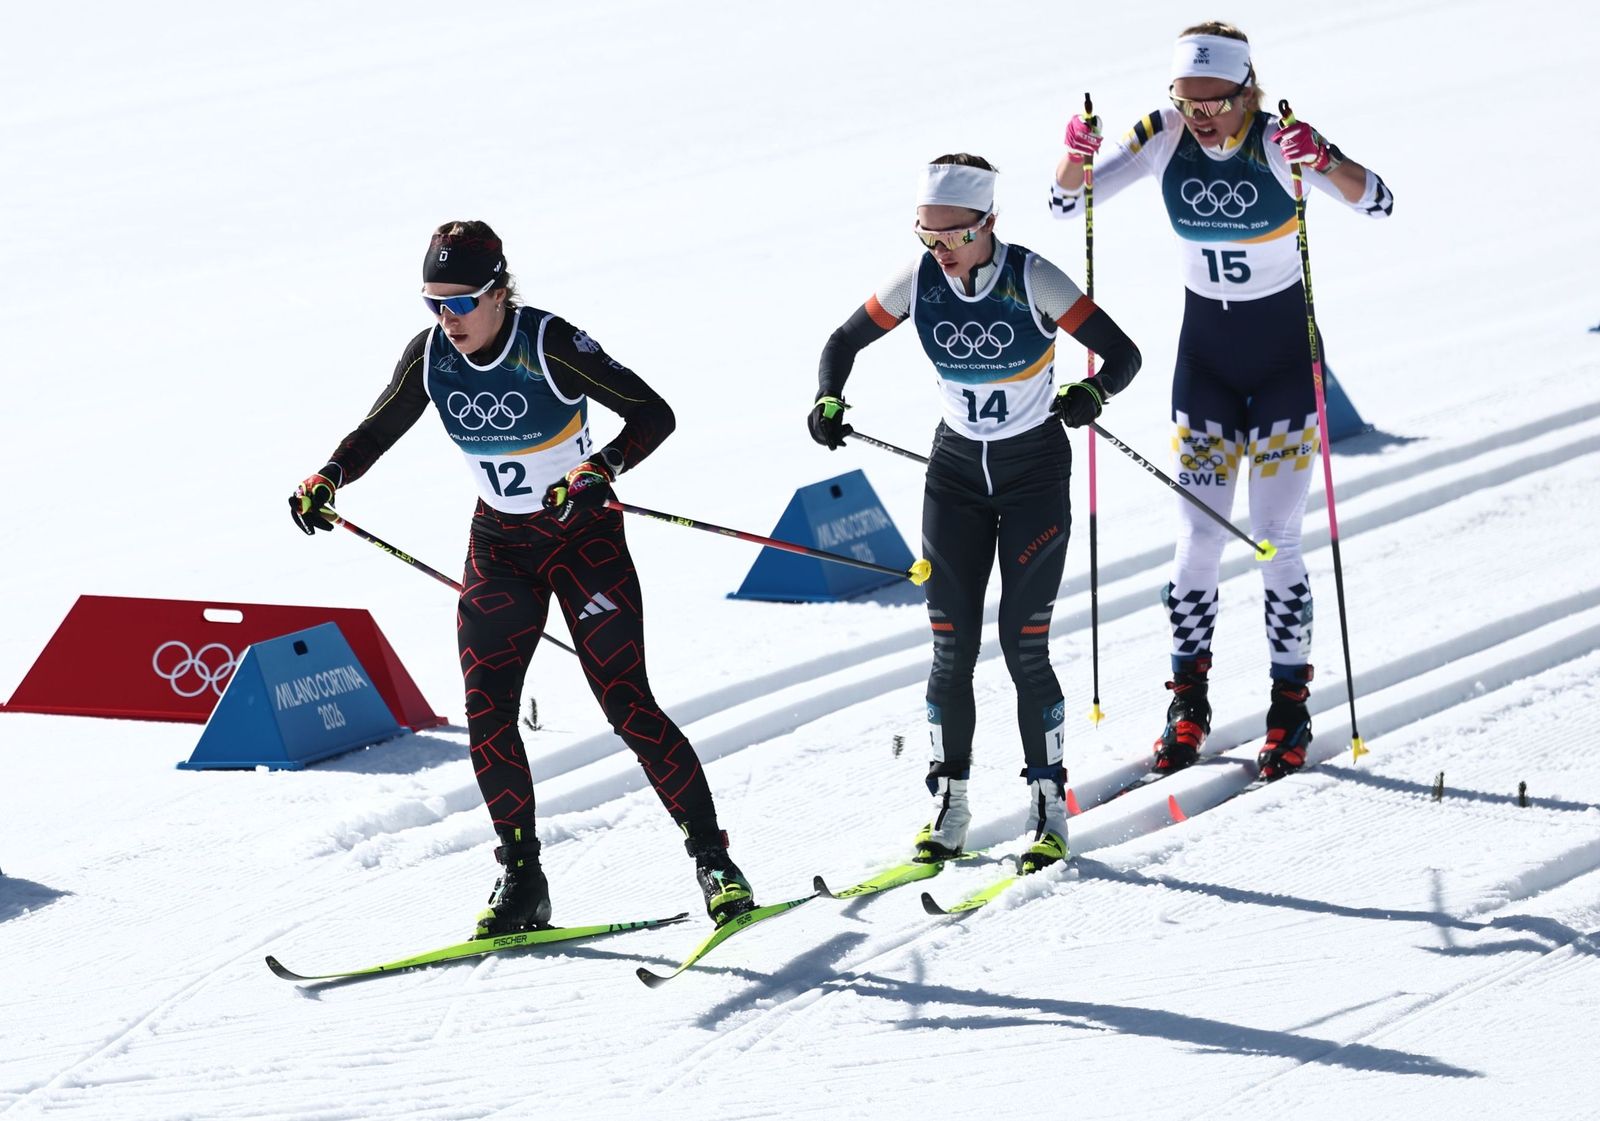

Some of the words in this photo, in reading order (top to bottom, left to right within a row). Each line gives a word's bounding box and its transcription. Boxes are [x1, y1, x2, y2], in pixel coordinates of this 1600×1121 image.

[1177, 218, 1211, 228] MILANO
[1211, 221, 1249, 230] CORTINA
[1250, 220, 1270, 230] 2026
[1296, 206, 1308, 252] LEKI
[1201, 248, 1252, 285] 15
[935, 361, 968, 370] MILANO
[1008, 359, 1026, 368] 2026
[962, 388, 1010, 424] 14
[450, 432, 481, 442] MILANO
[481, 434, 520, 442] CORTINA
[522, 431, 542, 440] 2026
[1254, 446, 1299, 464] CRAFT
[479, 460, 533, 497] 12
[1178, 472, 1227, 486] SWE
[1018, 525, 1058, 565] BIVIUM
[275, 676, 320, 711] MILANO
[315, 665, 368, 698] CORTINA
[317, 702, 347, 731] 2026
[493, 934, 528, 948] FISCHER
